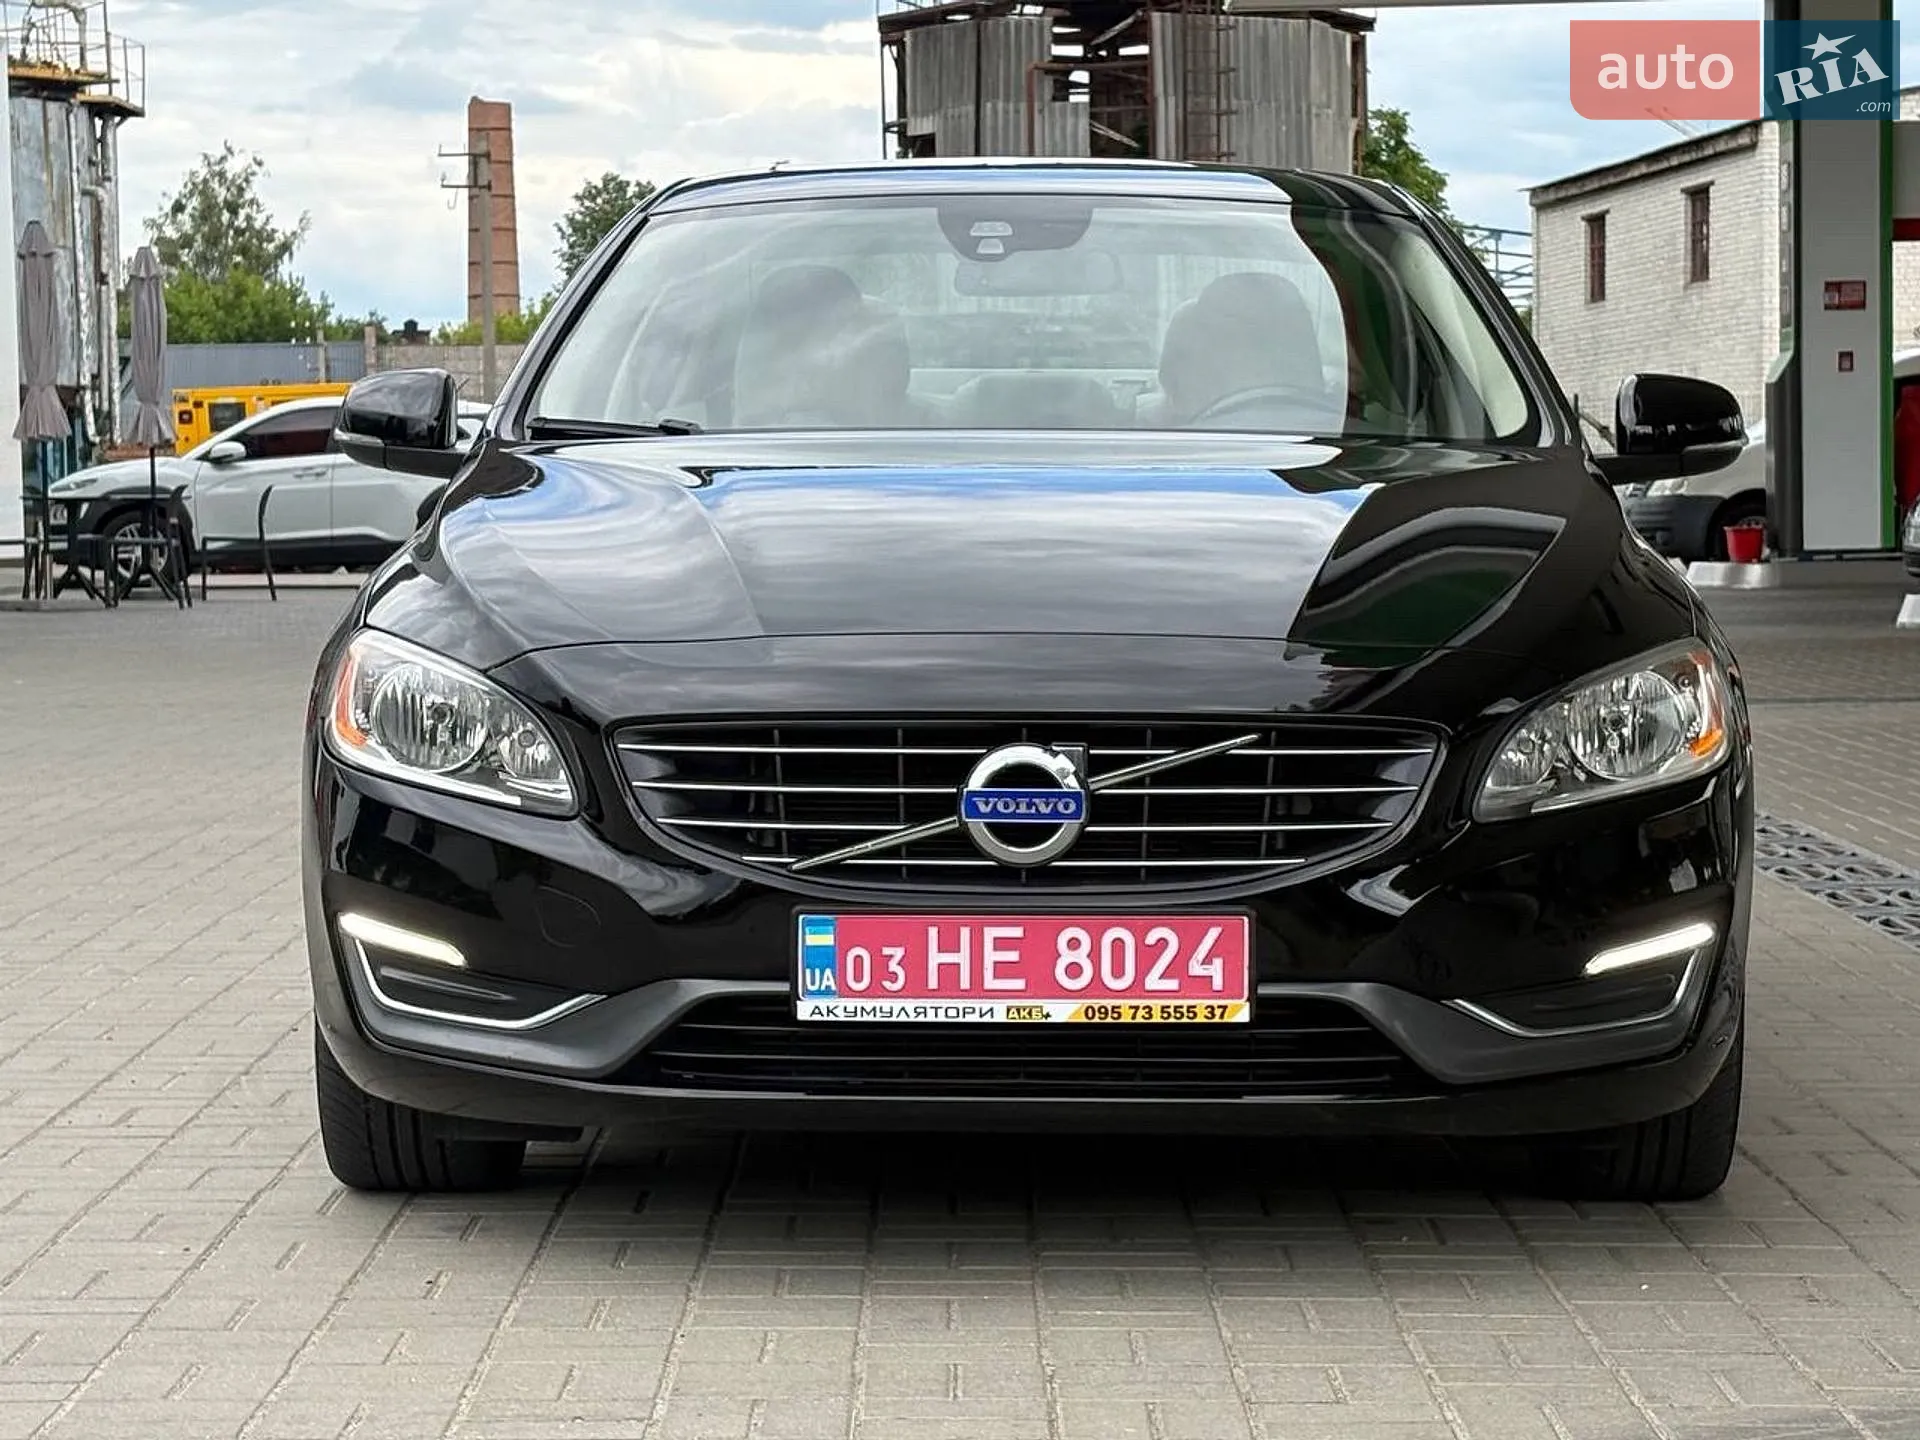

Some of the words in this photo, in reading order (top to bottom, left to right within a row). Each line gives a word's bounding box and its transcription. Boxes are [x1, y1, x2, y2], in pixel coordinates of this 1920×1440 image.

[972, 797, 1077, 815] VOLVO
[846, 946, 906, 992] 03
[927, 926, 1027, 990] HE
[1054, 926, 1224, 991] 8024
[805, 968, 836, 991] UA
[809, 1005, 995, 1019] АКУМУЛЯТОРИ
[1084, 1005, 1122, 1020] 095
[1129, 1005, 1154, 1020] 73
[1160, 1005, 1198, 1020] 555
[1204, 1005, 1229, 1020] 37
